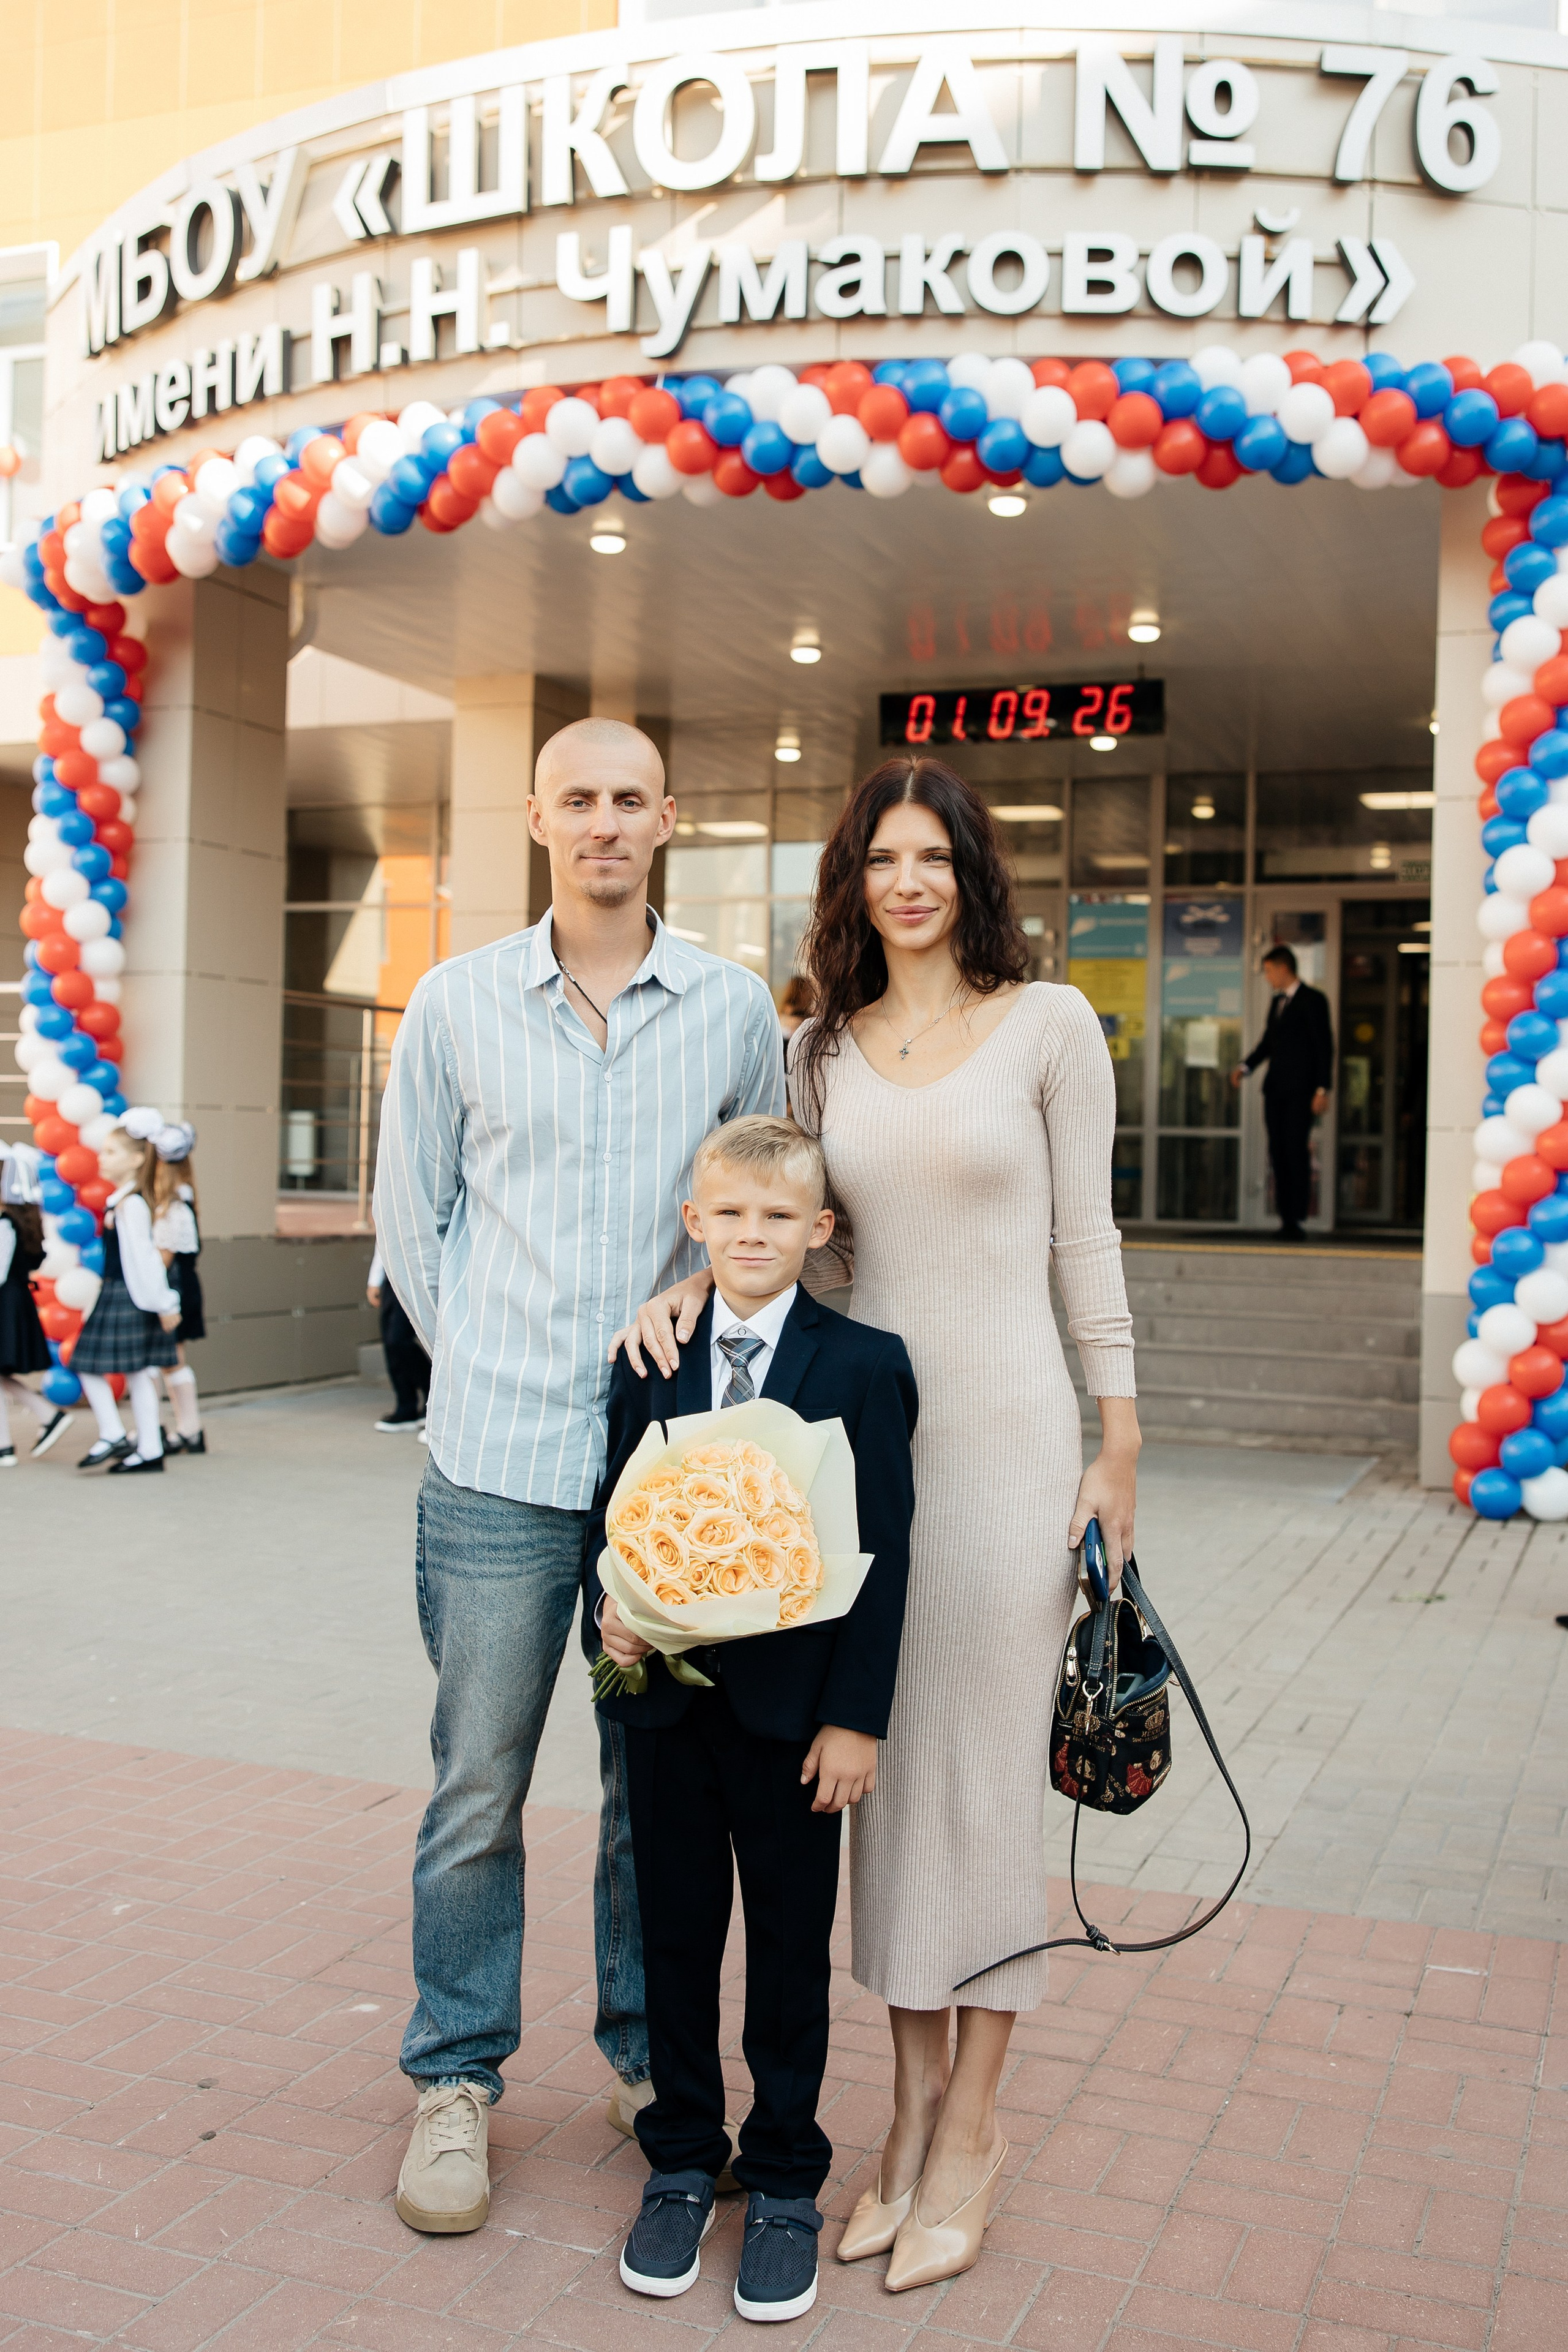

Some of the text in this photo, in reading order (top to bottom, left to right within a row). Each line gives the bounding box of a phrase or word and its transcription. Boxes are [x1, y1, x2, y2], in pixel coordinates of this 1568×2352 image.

[81, 37, 1501, 358] МБОУ «ШКОЛА № 76
[96, 206, 1417, 464] имени Н.Н. Чумаковой»
